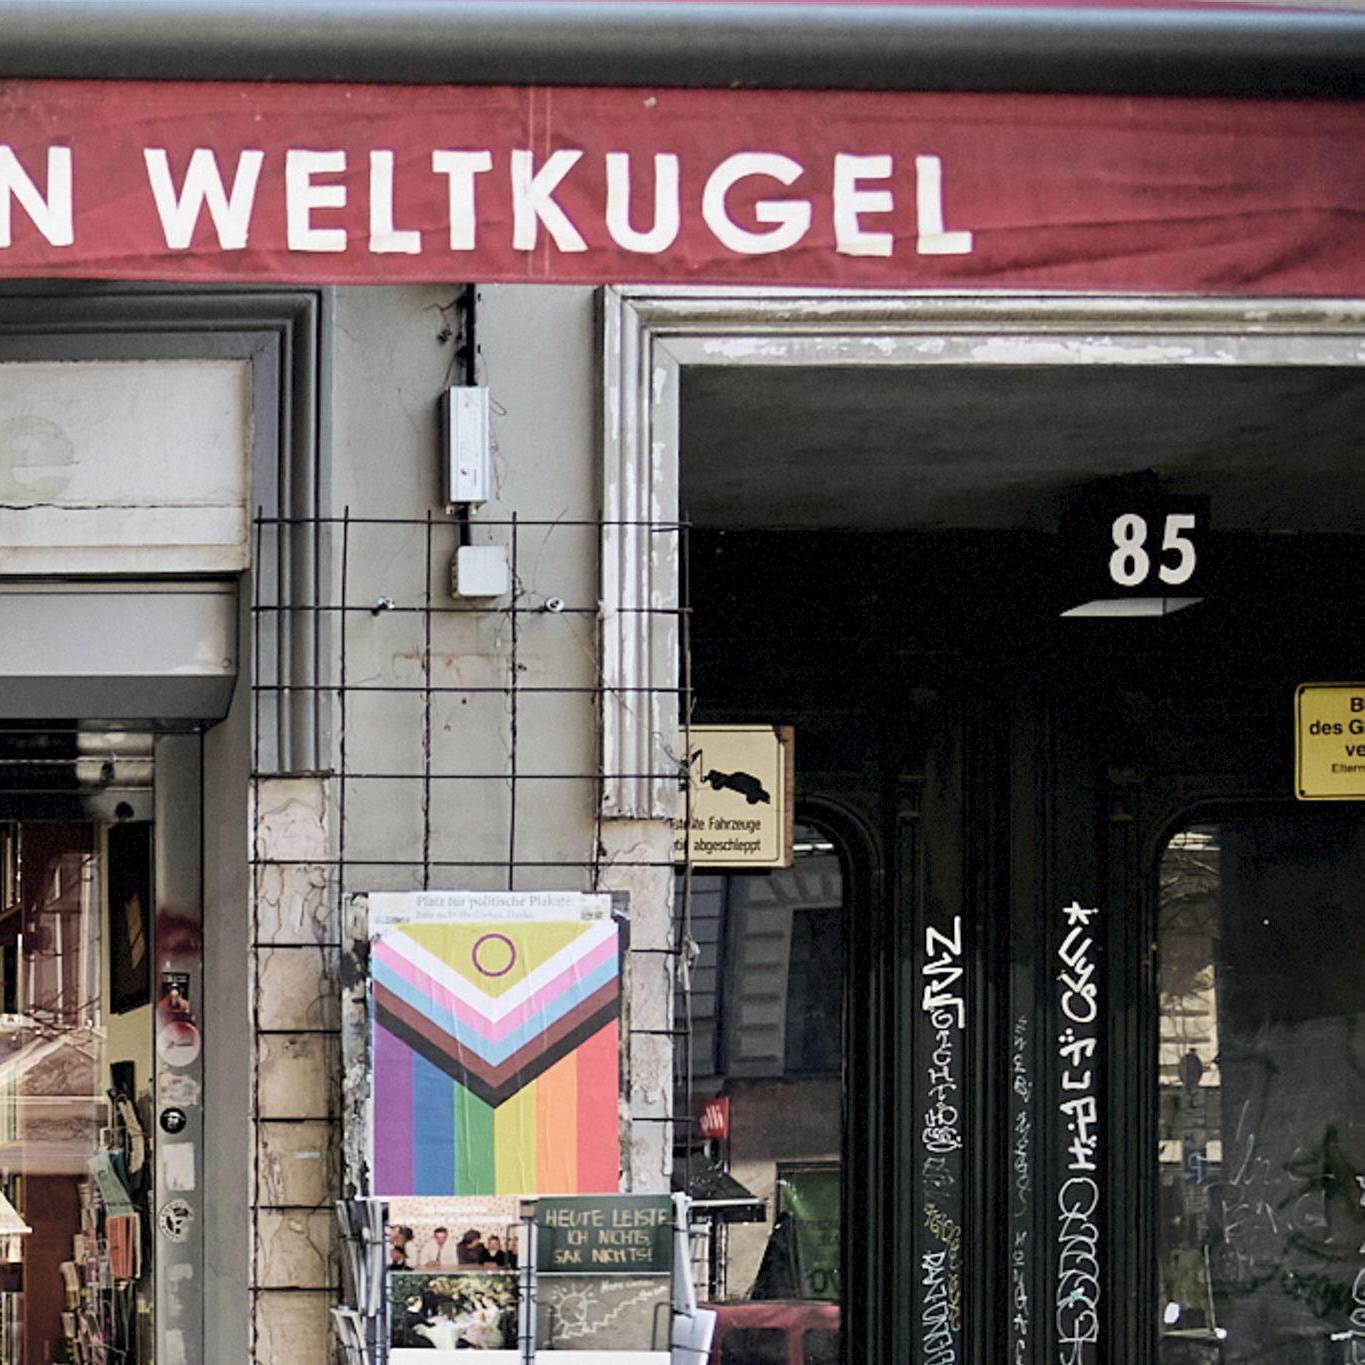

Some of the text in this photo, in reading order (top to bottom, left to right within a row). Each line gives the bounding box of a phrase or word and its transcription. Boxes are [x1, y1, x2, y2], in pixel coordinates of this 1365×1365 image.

[144, 148, 974, 258] WELTKUGEL
[1108, 513, 1198, 587] 85
[1309, 720, 1343, 735] des
[709, 815, 761, 834] Fahrzeuge
[693, 837, 761, 855] abgeschleppt
[545, 1207, 669, 1228] HEUTE LEISTE
[567, 1229, 589, 1246] ICH
